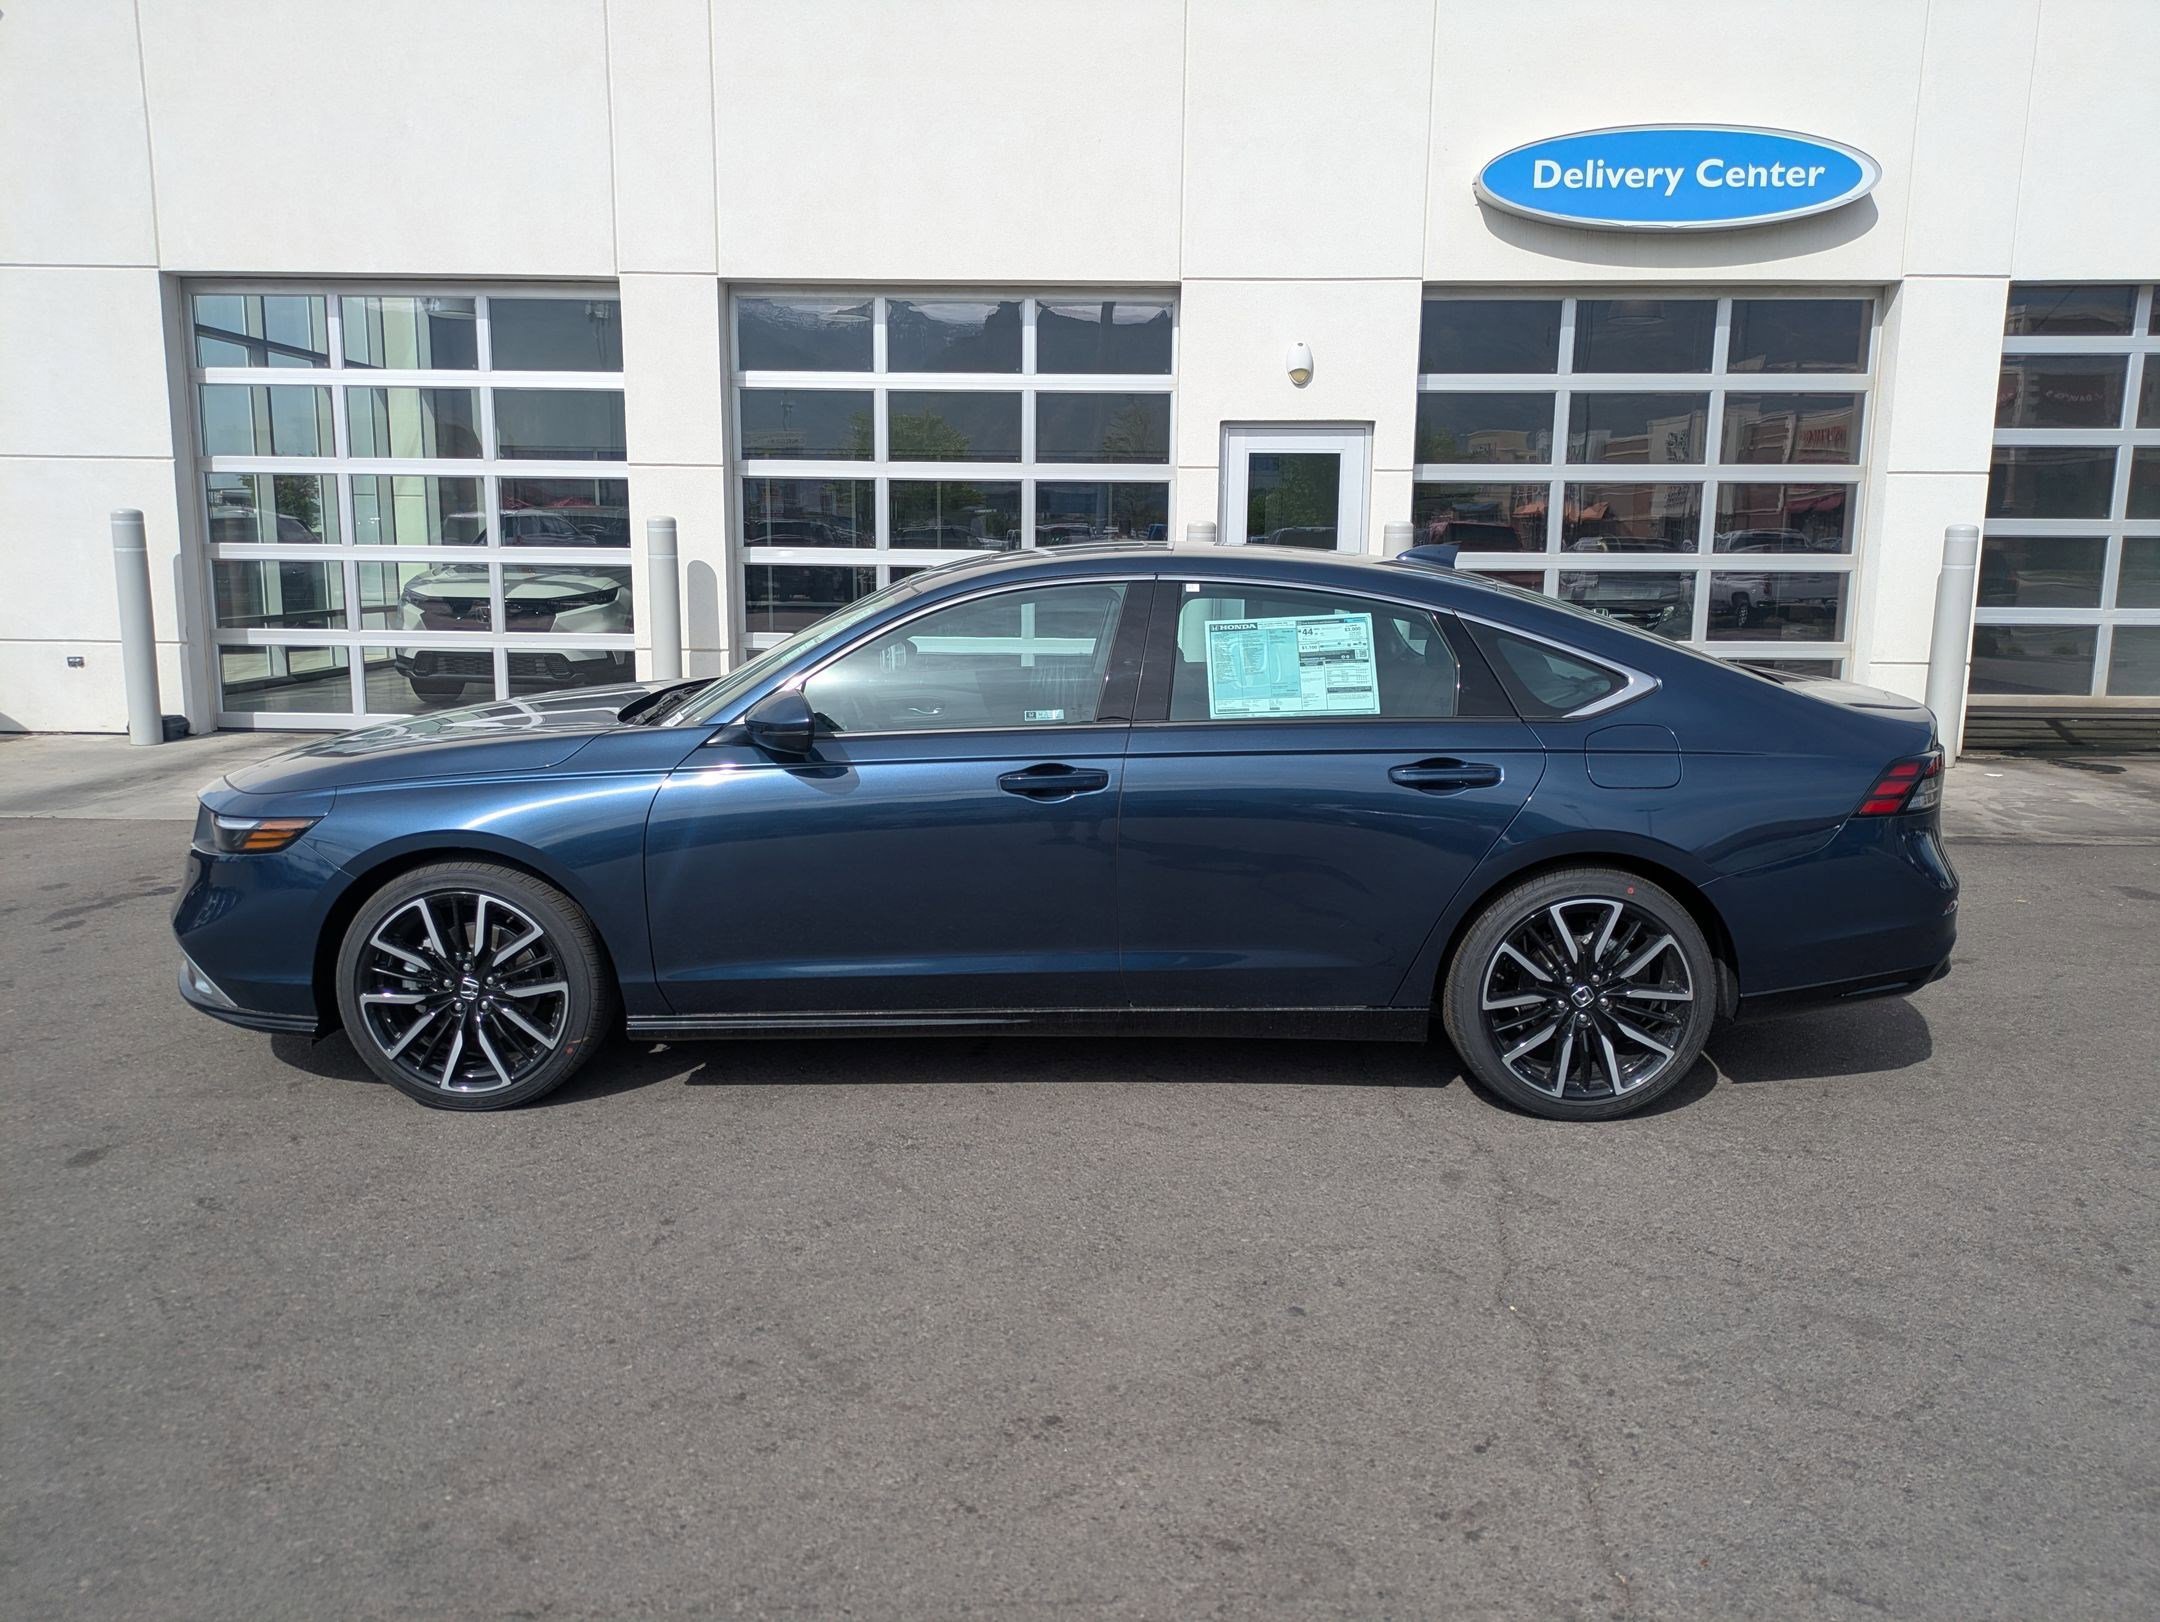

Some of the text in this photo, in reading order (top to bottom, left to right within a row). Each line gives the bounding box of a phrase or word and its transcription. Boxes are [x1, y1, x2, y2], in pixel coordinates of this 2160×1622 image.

[1533, 158, 1826, 197] Delivery Center
[1219, 623, 1257, 631] HONDA
